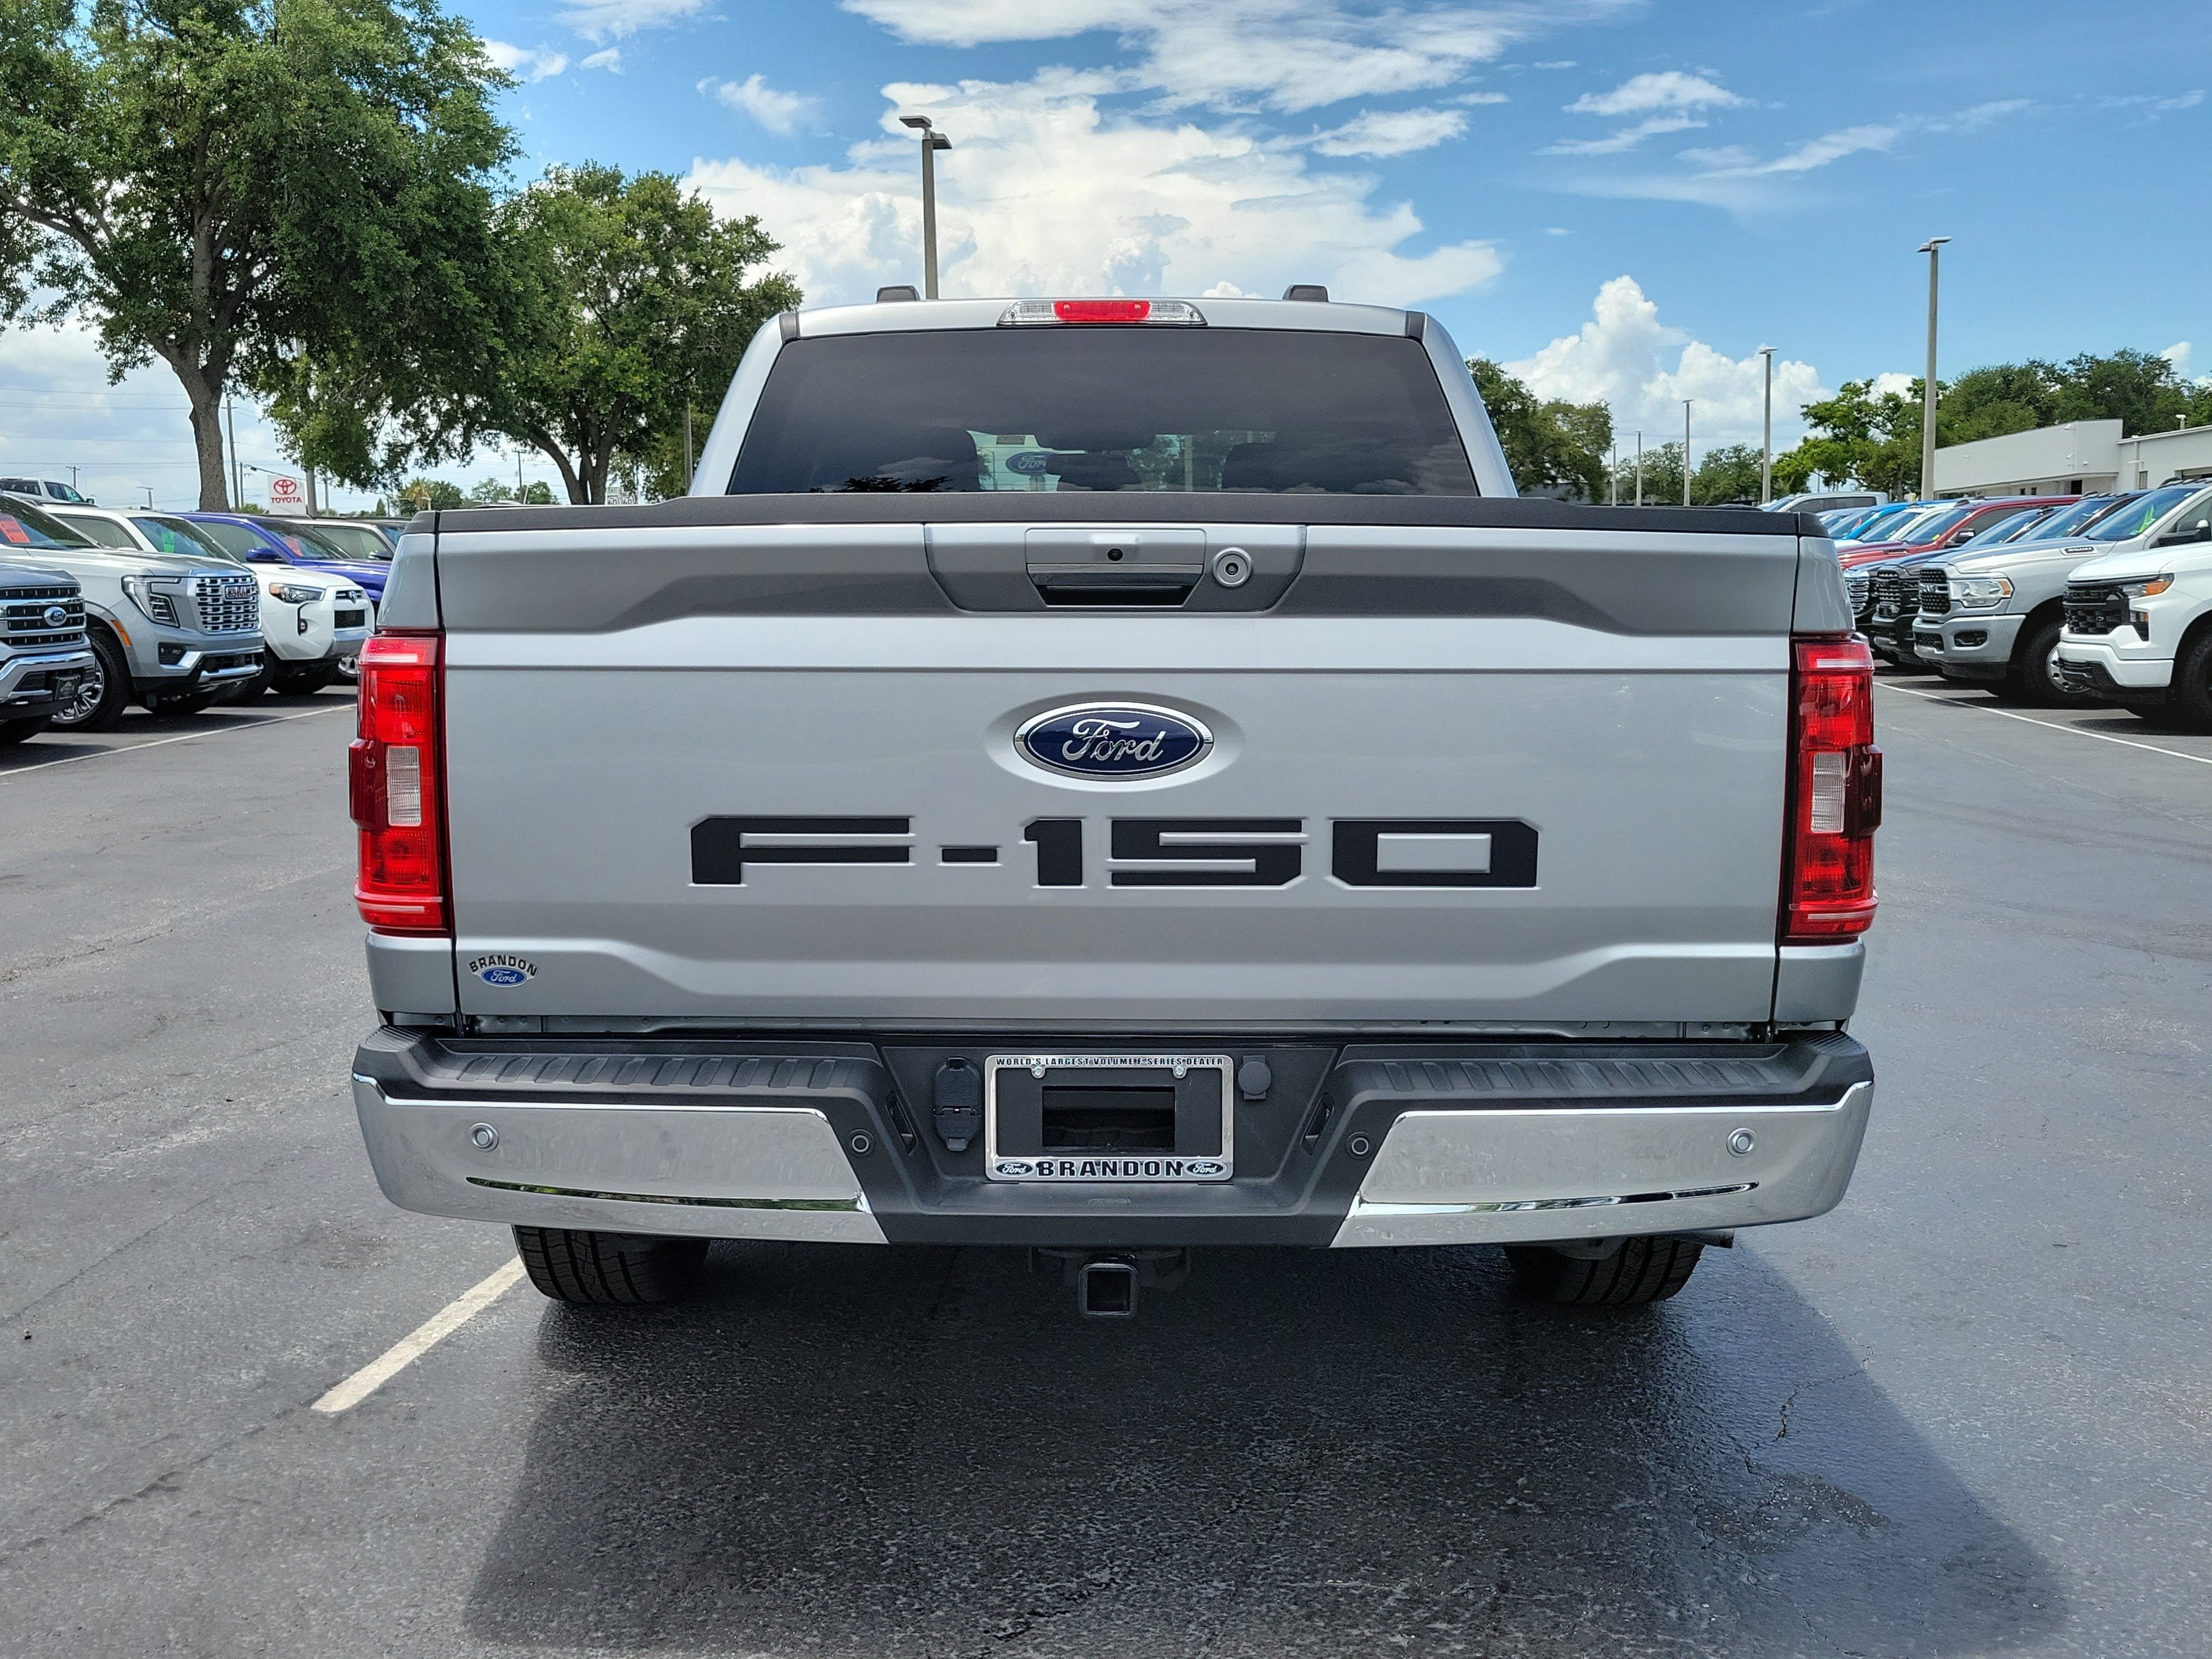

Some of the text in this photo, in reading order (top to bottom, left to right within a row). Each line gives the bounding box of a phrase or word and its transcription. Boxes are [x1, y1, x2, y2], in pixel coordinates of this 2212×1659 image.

[1018, 454, 1047, 470] For
[1062, 718, 1167, 761] Ford
[690, 816, 1539, 888] F-150
[469, 955, 538, 976] BRANDON
[490, 969, 517, 983] Ford
[1002, 1160, 1218, 1177] Ford BRANDON Ford
